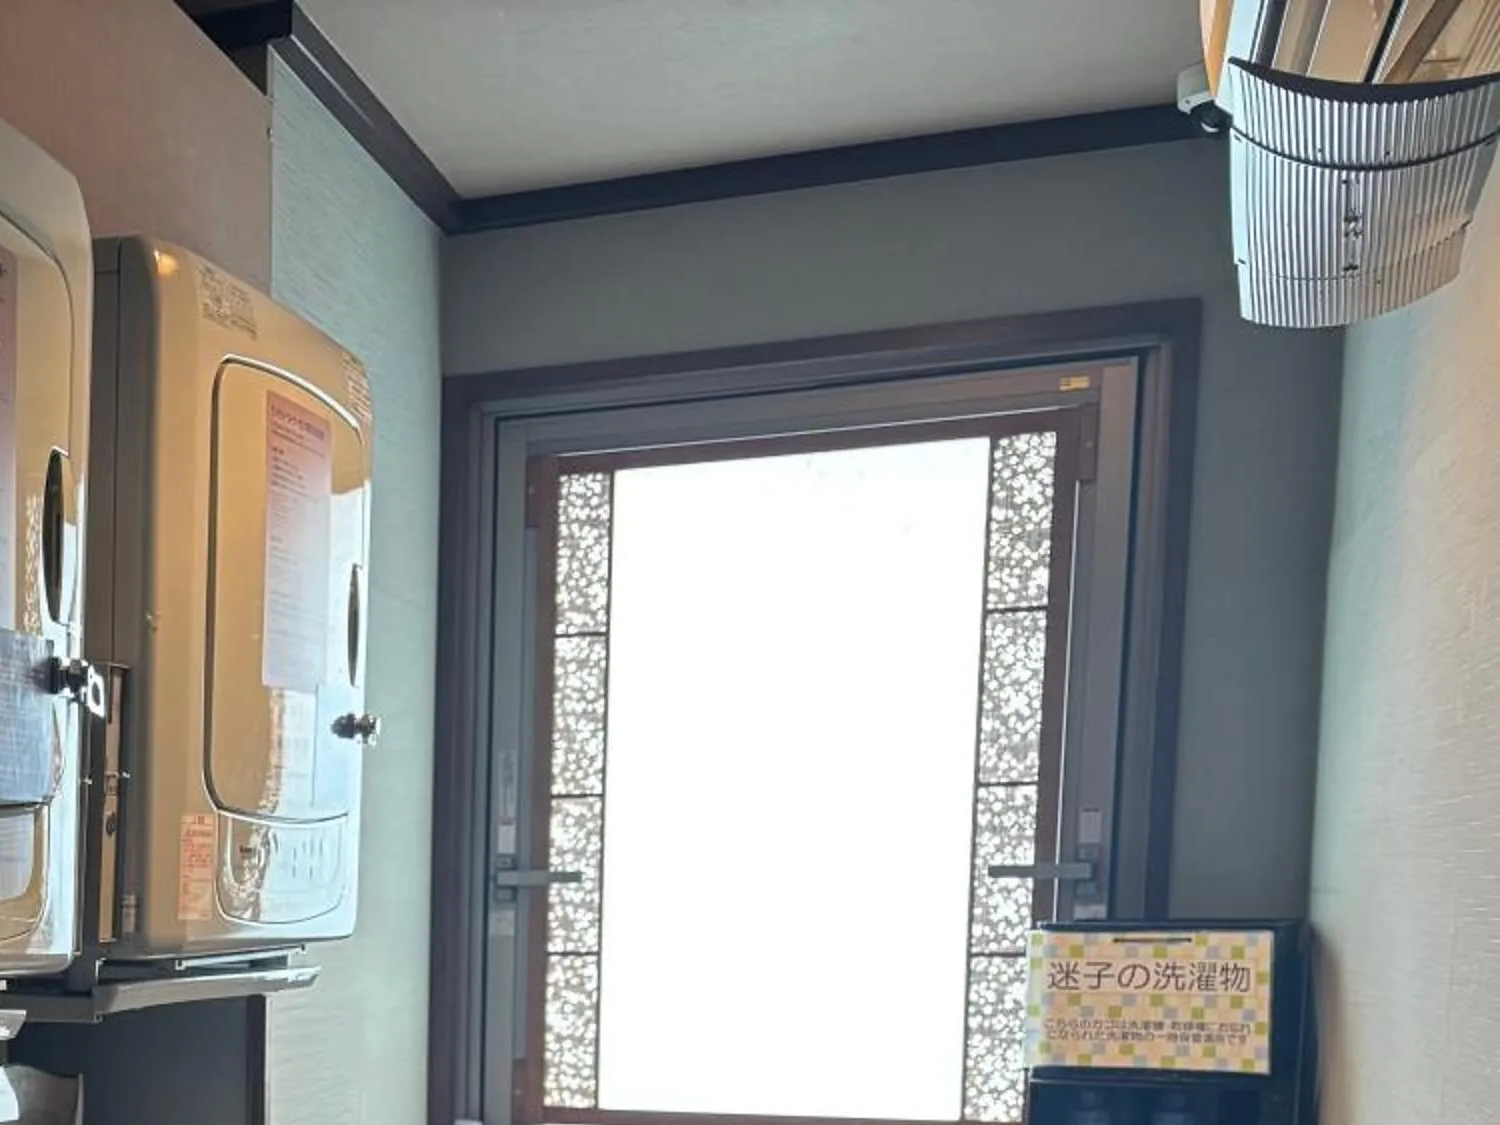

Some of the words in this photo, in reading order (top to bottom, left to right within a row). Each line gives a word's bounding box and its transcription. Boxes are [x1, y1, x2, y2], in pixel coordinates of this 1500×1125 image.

[1047, 961, 1252, 993] 迷子の洗濯物
